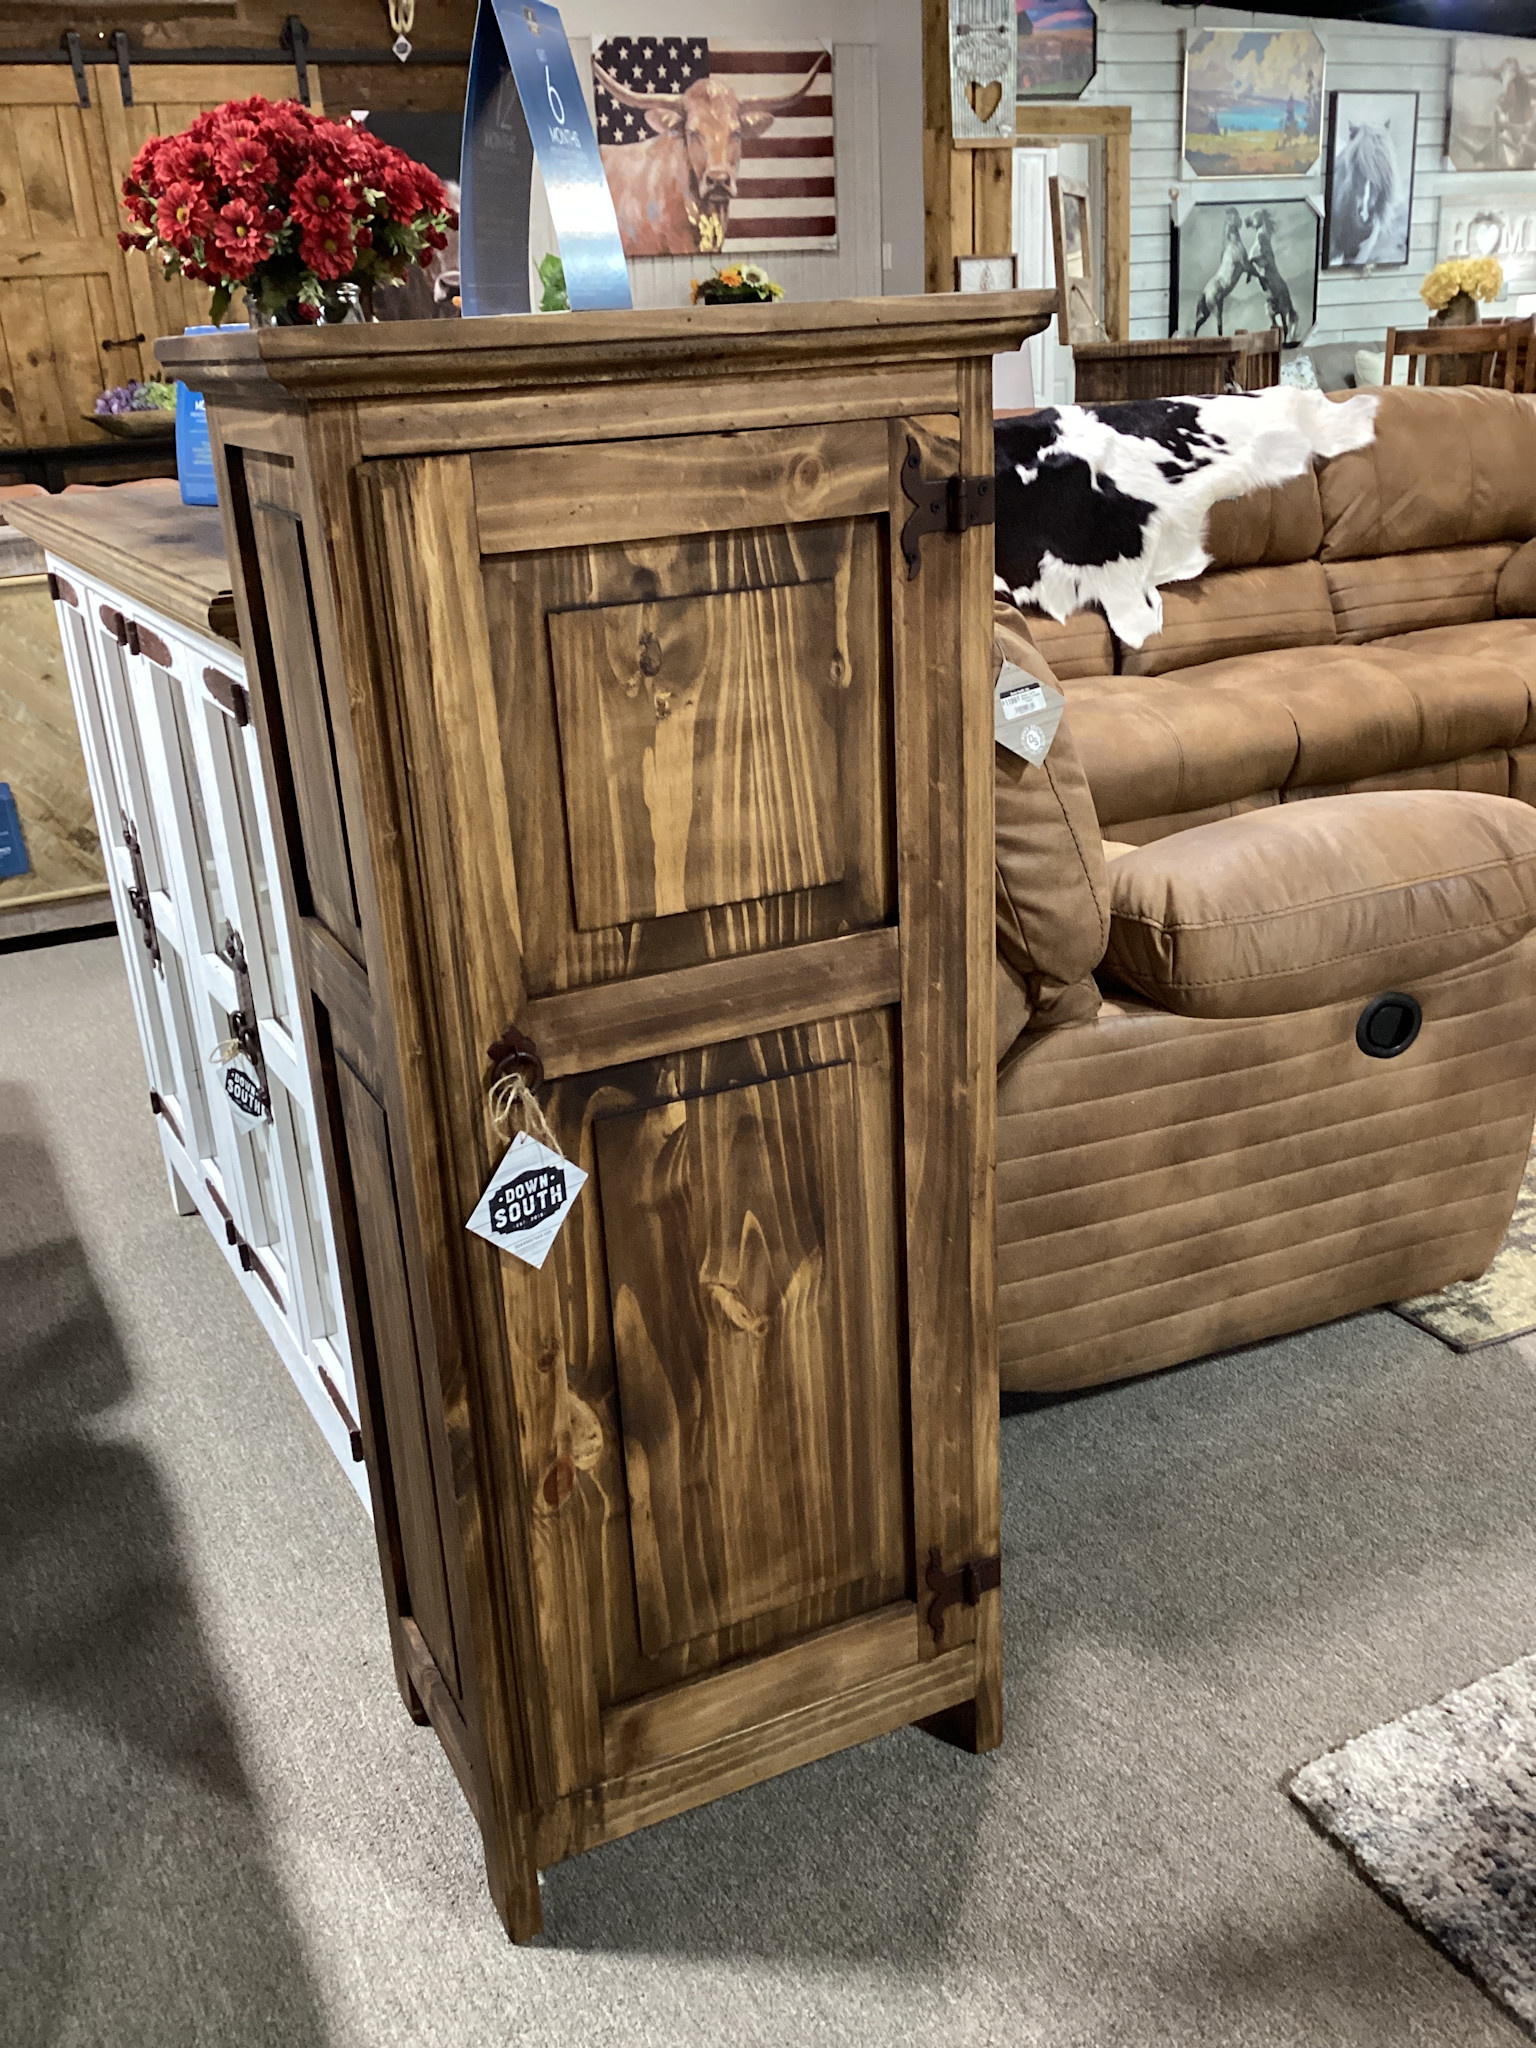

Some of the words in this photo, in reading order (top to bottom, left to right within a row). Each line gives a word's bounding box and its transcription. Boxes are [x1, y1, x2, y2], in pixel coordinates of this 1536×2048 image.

[545, 65, 565, 125] 6
[226, 1079, 261, 1115] SOUTH
[234, 1072, 256, 1096] DOWN
[494, 1183, 564, 1229] SOUTH
[505, 1173, 549, 1204] DOWN
